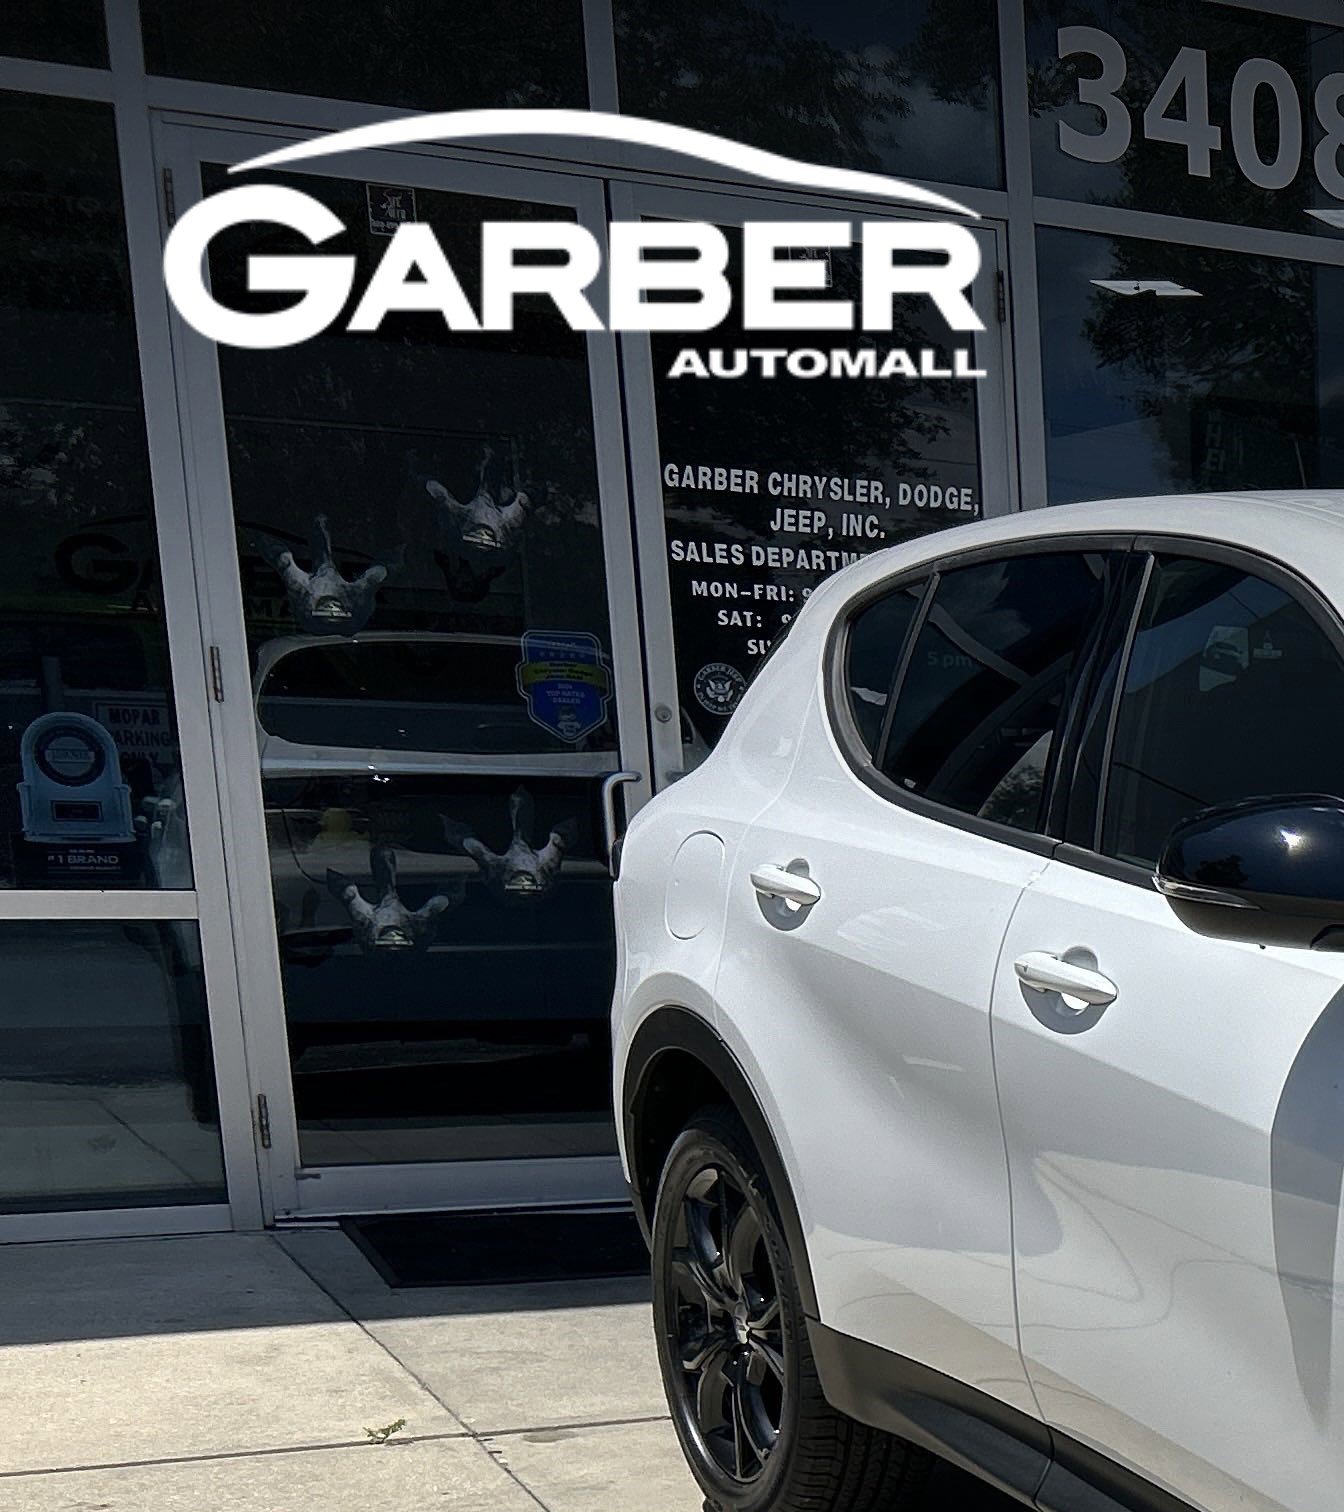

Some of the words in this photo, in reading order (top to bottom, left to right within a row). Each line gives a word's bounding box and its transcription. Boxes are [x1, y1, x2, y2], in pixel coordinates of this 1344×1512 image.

[663, 463, 759, 494] GARBER
[767, 472, 891, 509] CHRYSLER,
[898, 483, 980, 517] DODGE,
[770, 508, 834, 540] JEEP,
[841, 512, 886, 539] INC.
[670, 540, 745, 566] SALES
[751, 545, 870, 571] DEPARTM
[691, 580, 795, 602] MON-FRI:
[717, 609, 763, 628] SAT:
[108, 707, 161, 726] MOPAR
[113, 729, 171, 748] ARKING
[66, 854, 119, 866] BRAND
